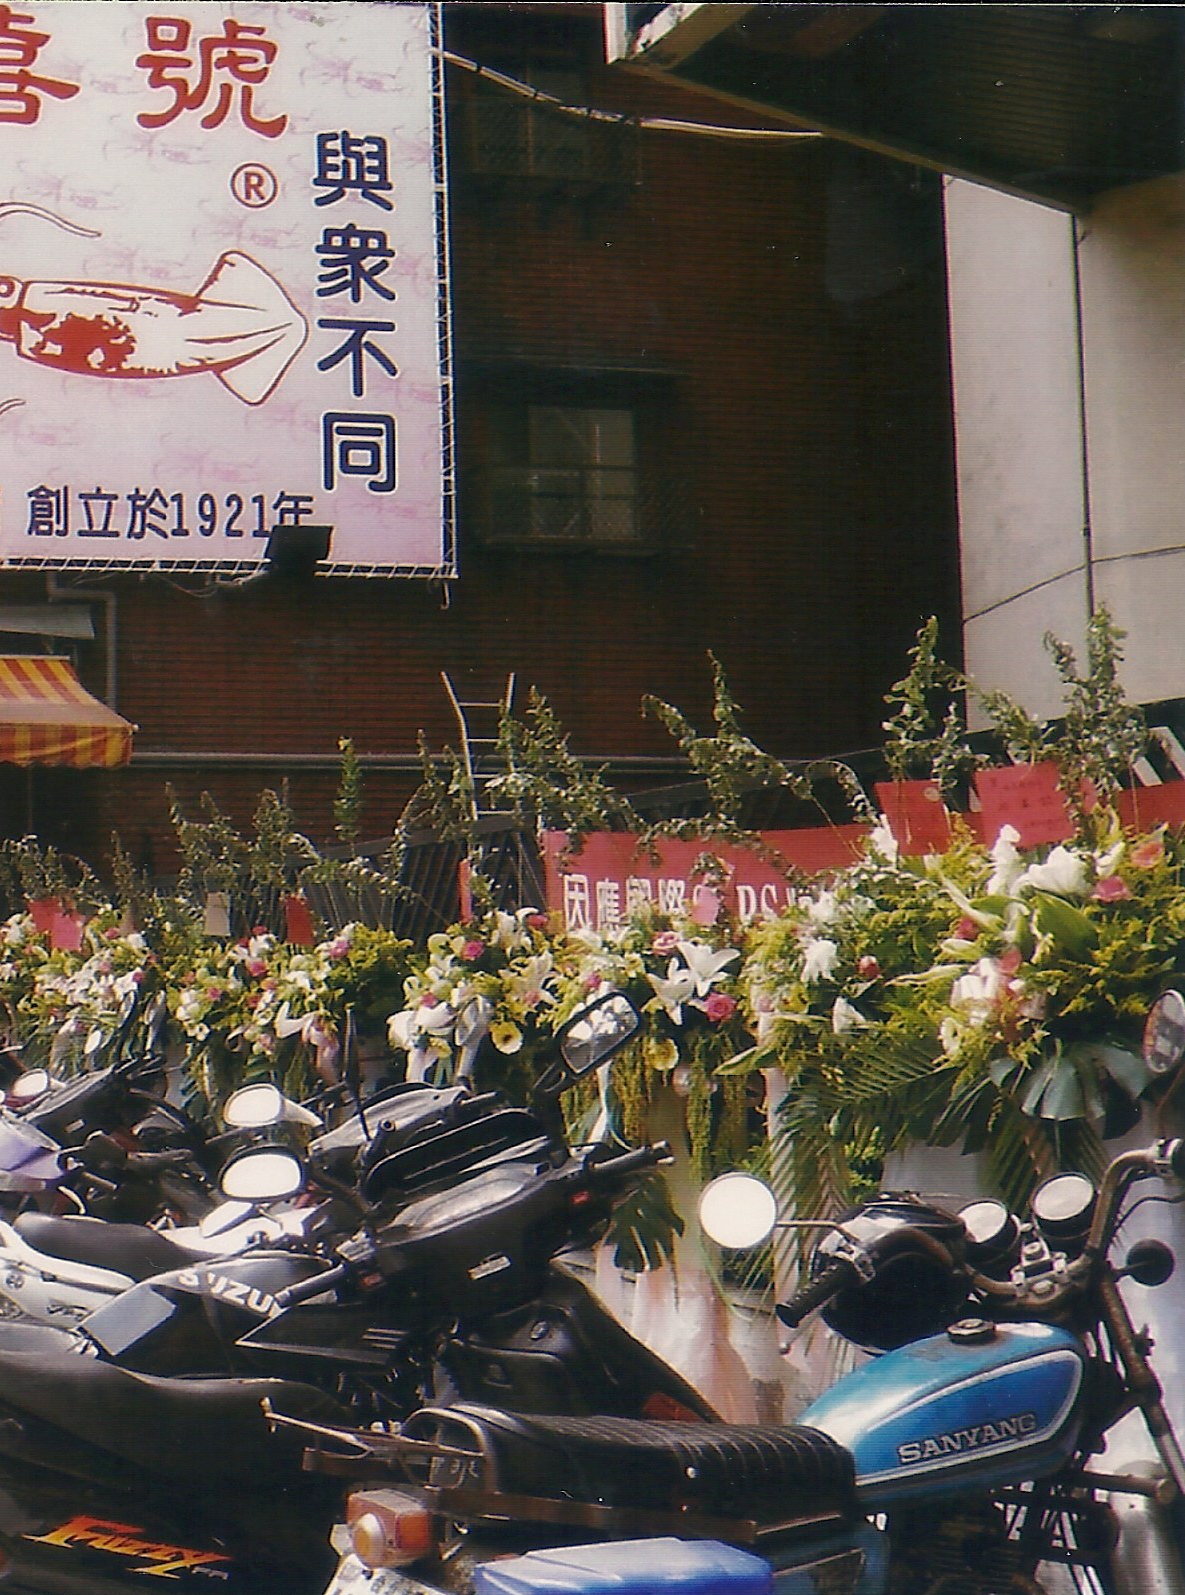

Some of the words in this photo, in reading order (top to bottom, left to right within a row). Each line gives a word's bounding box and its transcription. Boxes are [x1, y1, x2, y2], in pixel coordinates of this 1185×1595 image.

[26, 484, 315, 540] 創立於1921年
[898, 1414, 1036, 1464] SANYANG
